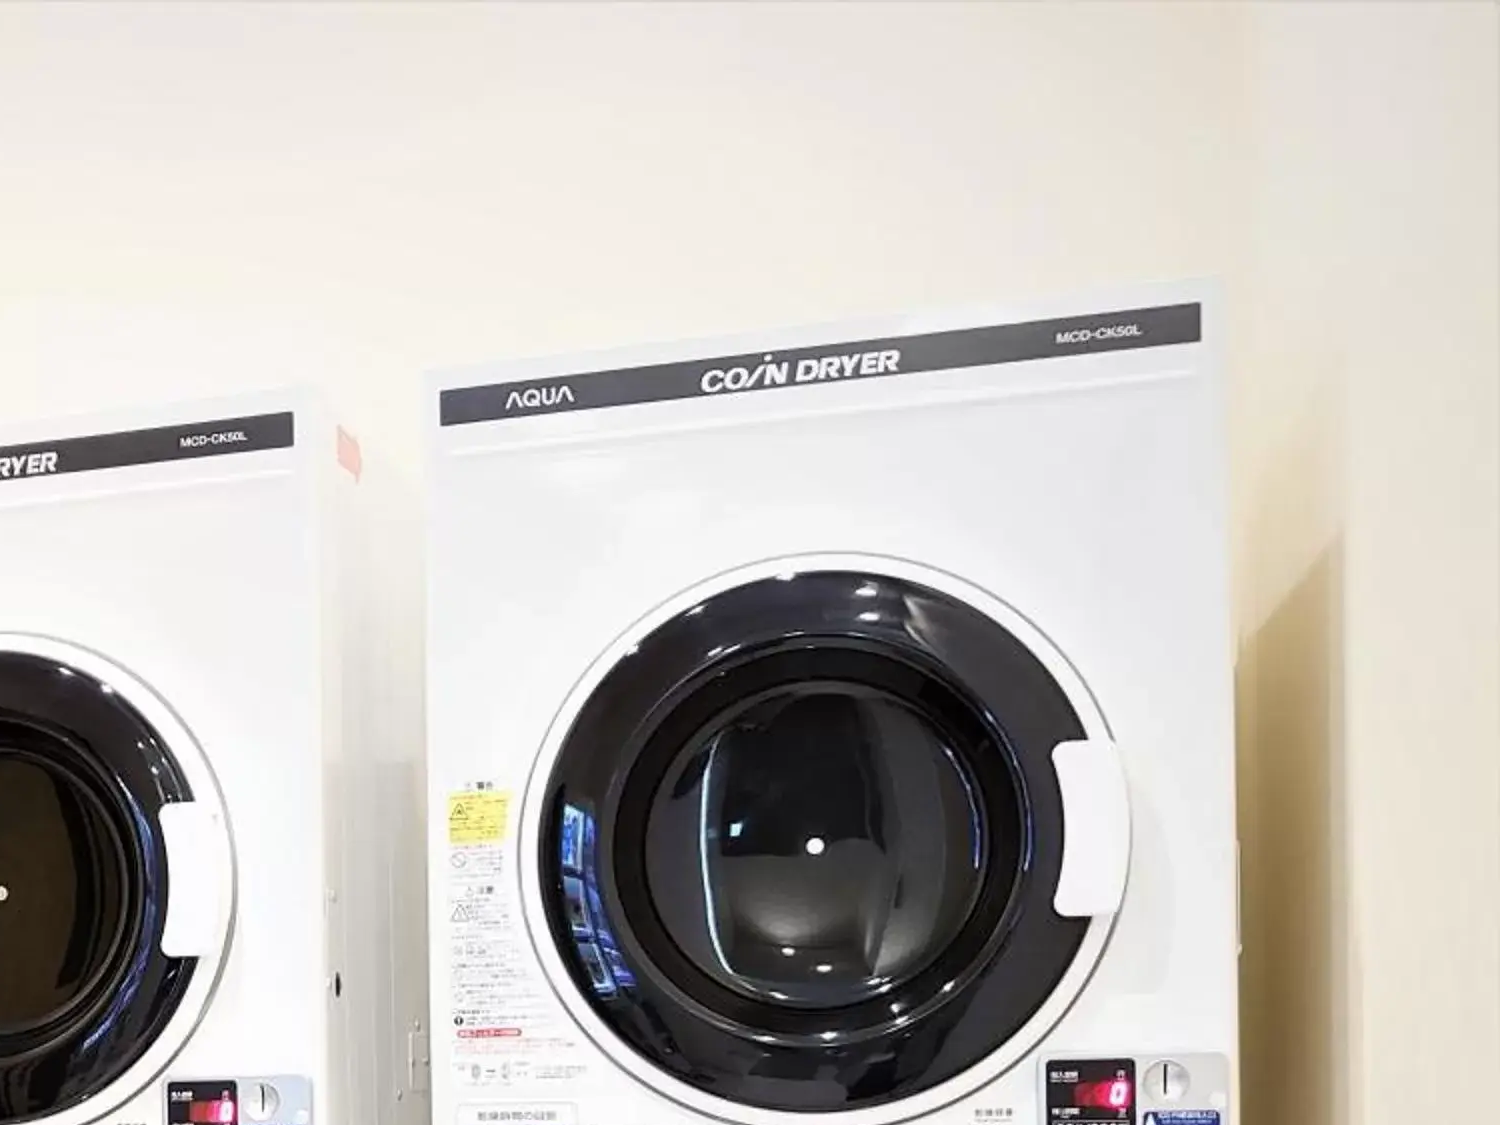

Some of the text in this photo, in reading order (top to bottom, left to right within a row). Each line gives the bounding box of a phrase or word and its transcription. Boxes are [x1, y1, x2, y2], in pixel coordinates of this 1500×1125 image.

[1056, 324, 1142, 344] MCD-CK50L
[795, 349, 901, 382] DRYER
[505, 385, 575, 410] AQUA
